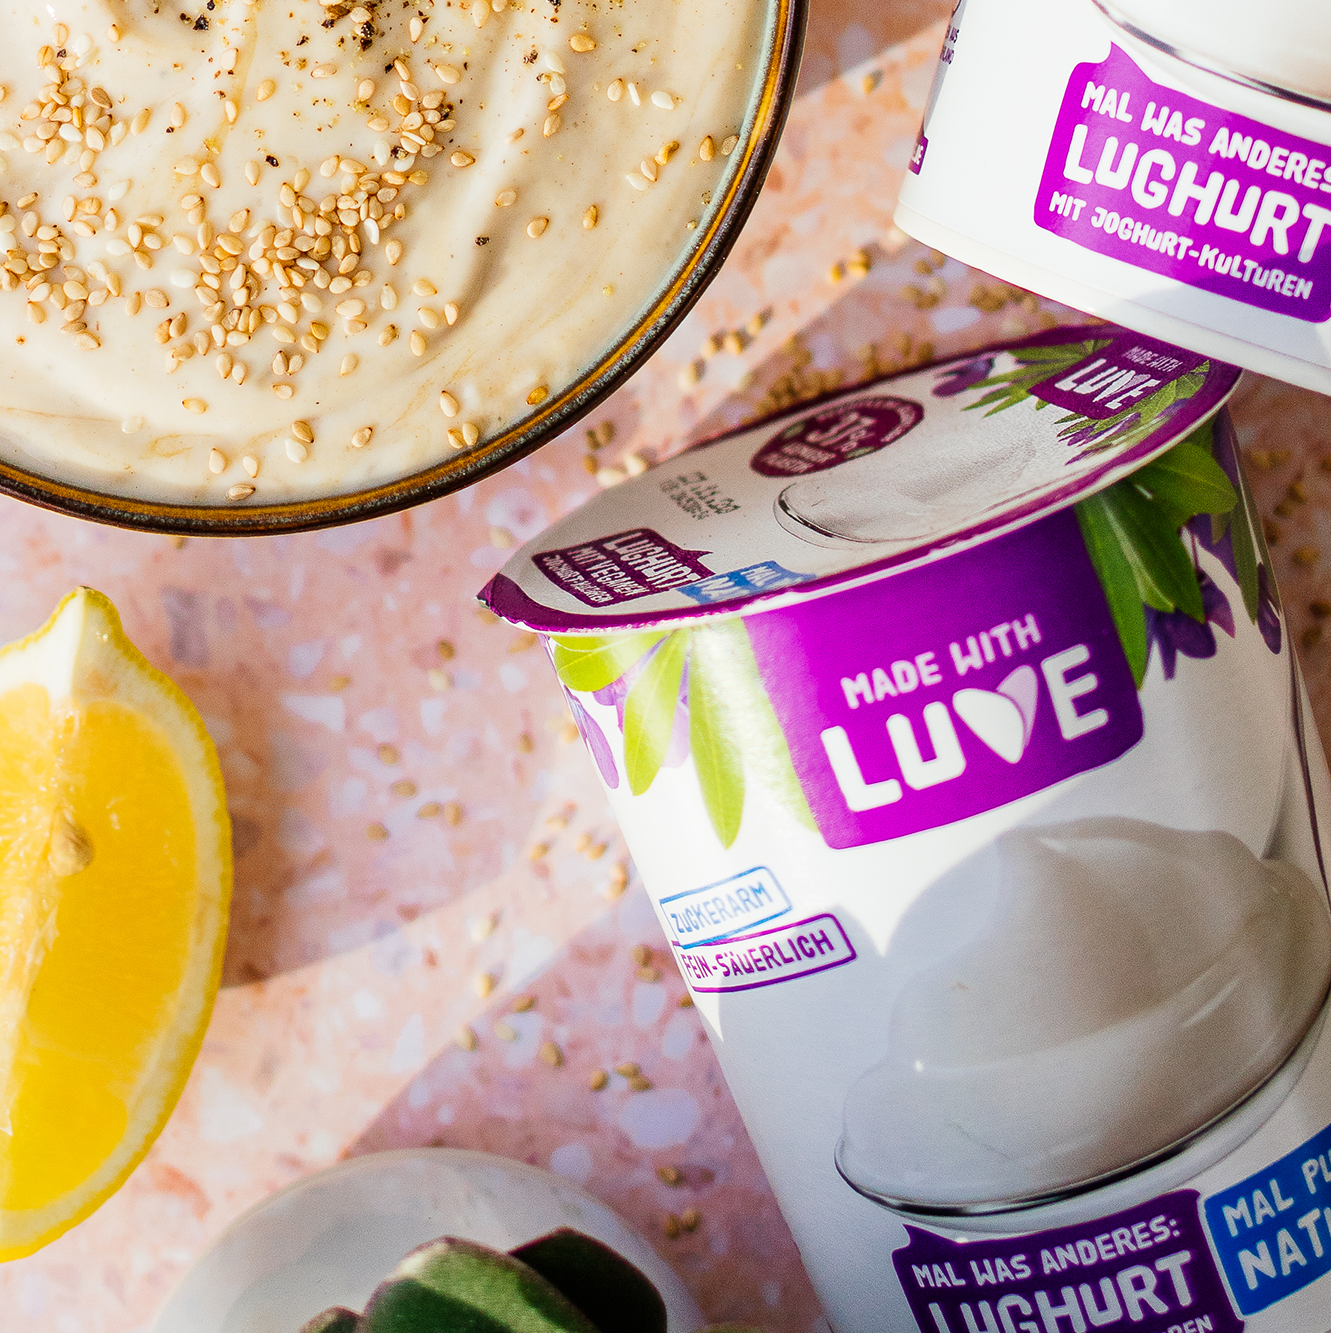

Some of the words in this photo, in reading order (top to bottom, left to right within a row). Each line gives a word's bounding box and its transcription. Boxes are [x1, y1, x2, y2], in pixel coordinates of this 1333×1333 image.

[1080, 81, 1133, 123] MAL
[1140, 101, 1205, 146] WAS
[1063, 124, 1331, 264] LUGHURT
[1049, 191, 1087, 221] MIT
[1091, 207, 1313, 300] JOGHURT-KULTUREN
[567, 546, 606, 565] MIT
[604, 532, 701, 588] LUGHURT
[840, 651, 943, 710] MADE
[949, 613, 1042, 676] WITH
[670, 882, 773, 934] ZUCKERARM
[681, 929, 835, 979] FEIN-SÄUERLICH
[1222, 1178, 1294, 1237] MAL
[912, 1263, 965, 1288] MAL
[970, 1254, 1031, 1286] WAS
[1040, 1214, 1181, 1274] ANDERES:
